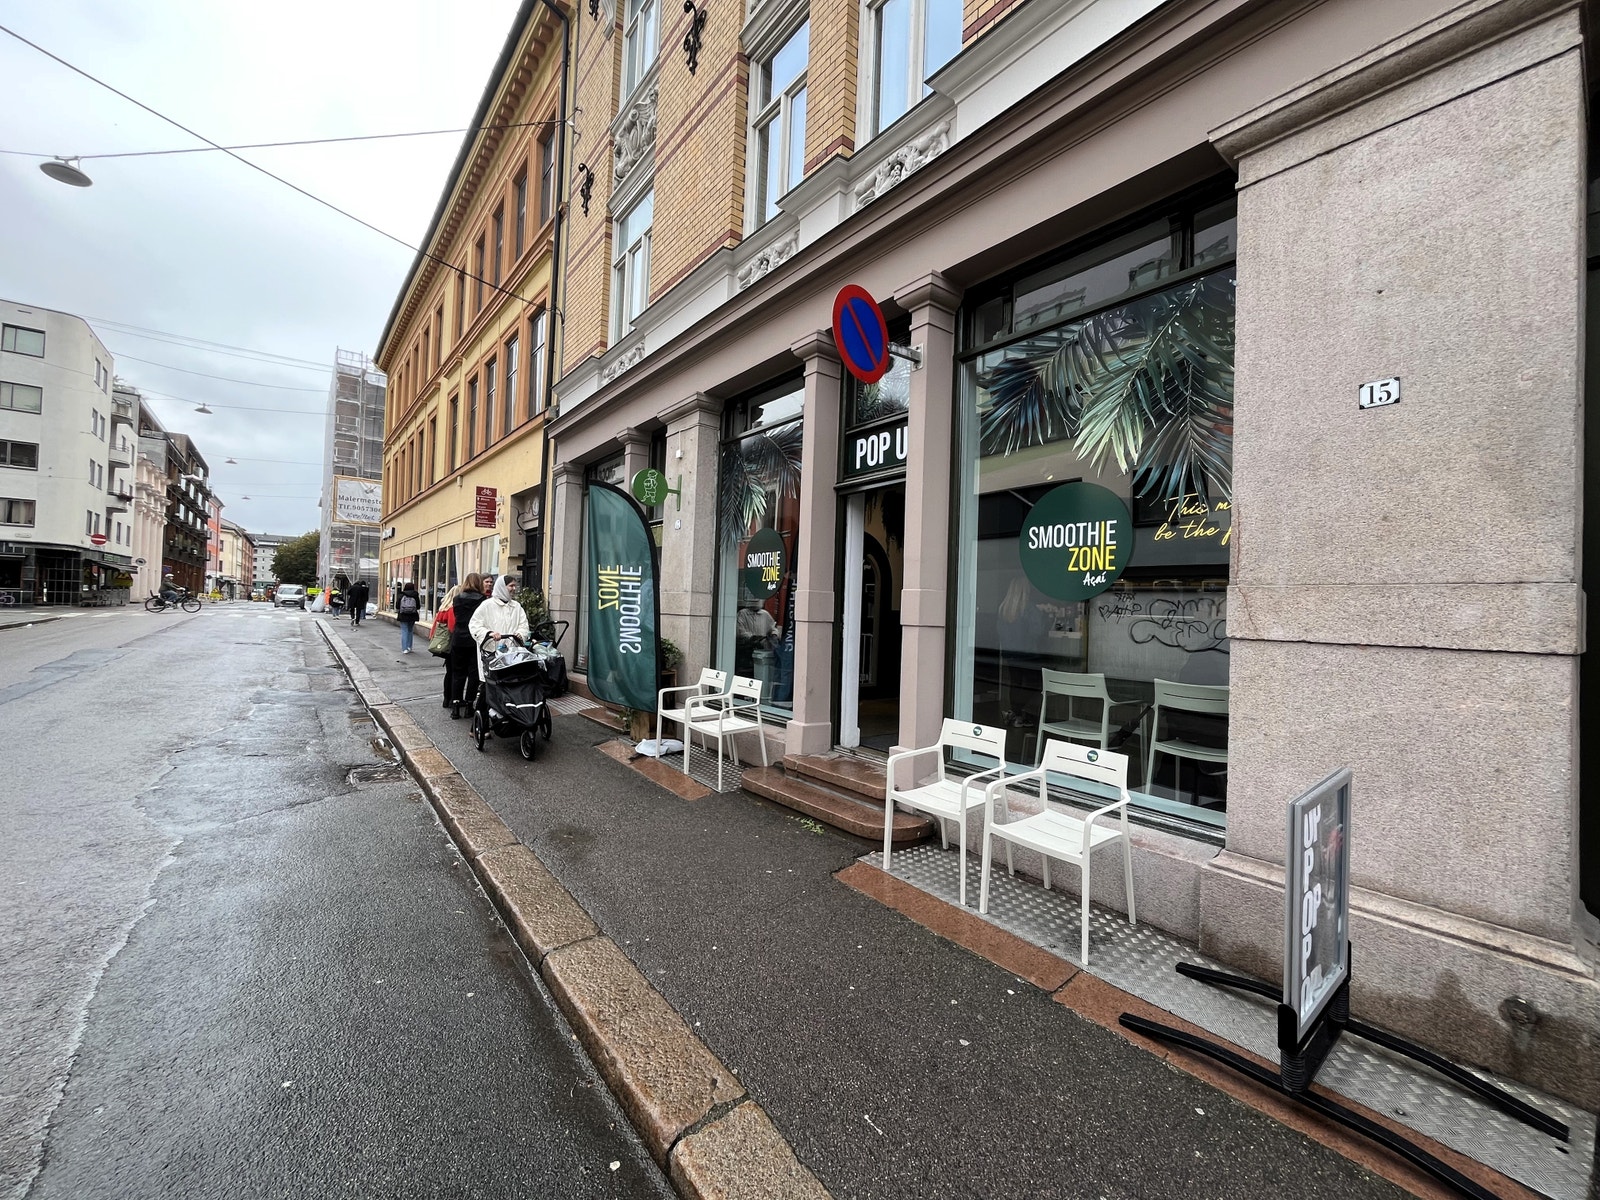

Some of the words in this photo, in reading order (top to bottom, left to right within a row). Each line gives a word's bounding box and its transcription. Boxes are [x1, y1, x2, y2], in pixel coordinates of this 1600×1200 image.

[1366, 382, 1392, 405] 15
[856, 431, 891, 470] POP
[1028, 519, 1118, 550] SMOOTHIE
[1154, 522, 1177, 541] be
[1179, 518, 1221, 539] the
[747, 551, 781, 568] SMOOTHIE
[1067, 545, 1116, 572] ZONE
[761, 566, 781, 582] ZONE
[1082, 571, 1107, 587] Açaí
